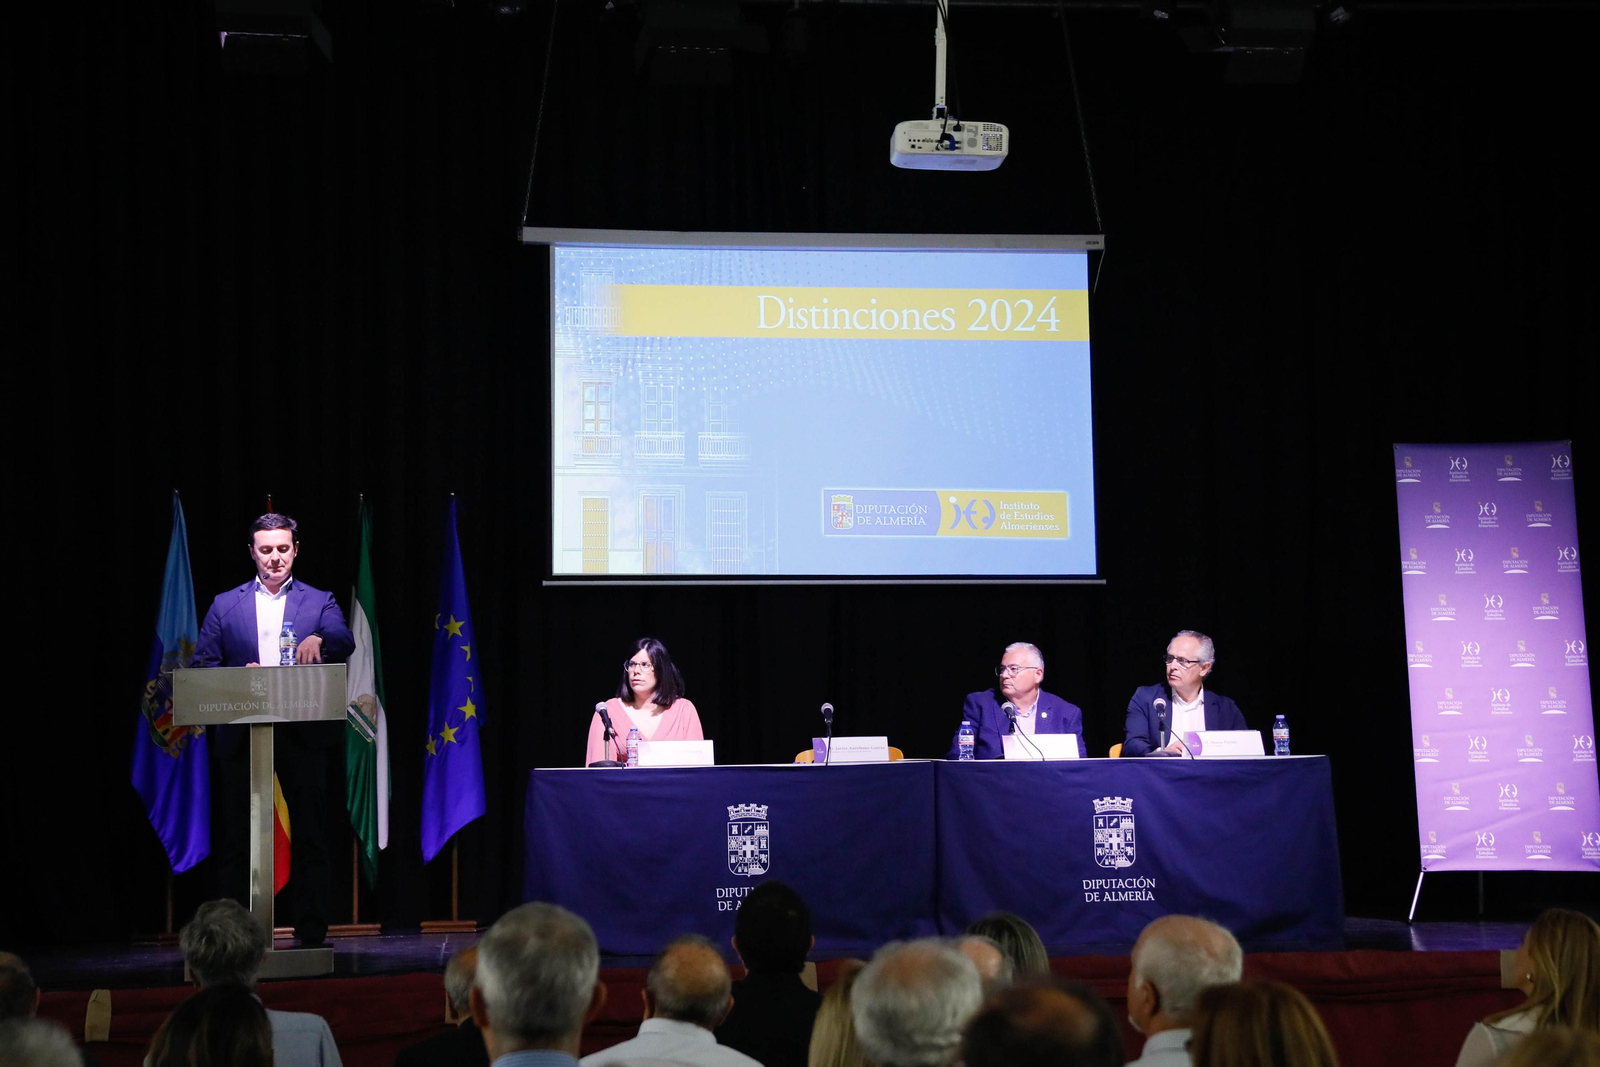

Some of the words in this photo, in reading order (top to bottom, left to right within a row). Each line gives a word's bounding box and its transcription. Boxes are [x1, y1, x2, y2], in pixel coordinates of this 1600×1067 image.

[757, 295, 956, 331] Distinciones
[967, 296, 1060, 332] 2024
[856, 502, 928, 514] DIPUTACIÓN
[1000, 501, 1040, 510] Instituto
[857, 516, 873, 525] DE
[875, 514, 926, 526] ALMERÍA
[1000, 512, 1012, 520] de
[1014, 512, 1054, 520] Estudios
[1000, 522, 1060, 531] Almerienses
[199, 701, 259, 712] DIPUTACIÓN
[1082, 876, 1155, 889] DIPUTACIÓN
[716, 887, 754, 898] DIPUT
[1085, 892, 1100, 902] DE
[1103, 889, 1155, 901] ALMERÍA
[718, 901, 733, 911] DE
